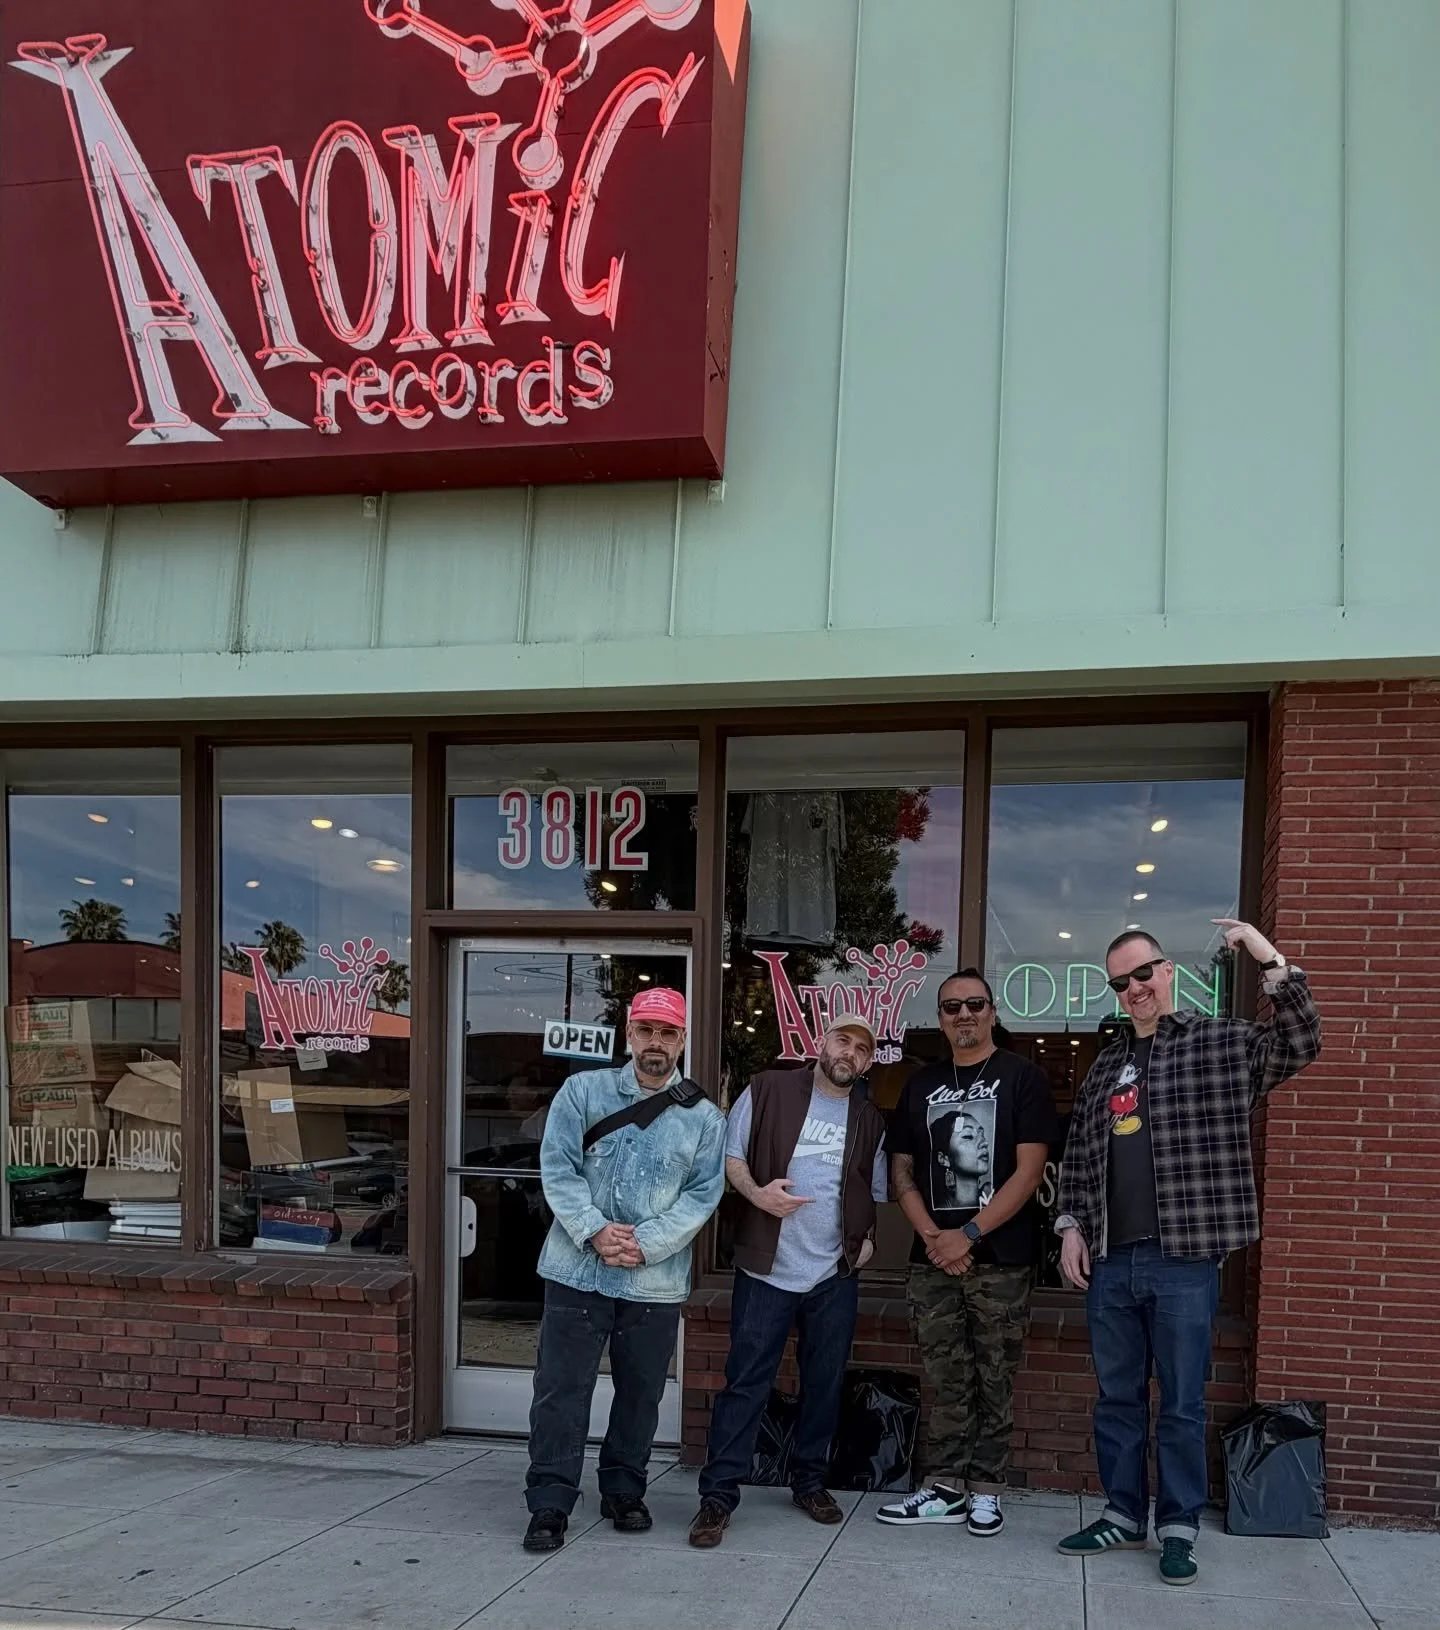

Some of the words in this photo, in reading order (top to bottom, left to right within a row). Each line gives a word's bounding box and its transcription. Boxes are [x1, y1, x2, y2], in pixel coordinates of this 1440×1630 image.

[309, 336, 615, 434] records
[498, 786, 649, 871] 3812
[1003, 963, 1220, 1018] OPN
[305, 1034, 370, 1053] records
[548, 1025, 611, 1055] OPEN
[968, 1079, 1000, 1099] Sol
[105, 1129, 182, 1173] ALBUMS
[822, 1153, 843, 1166] RECO
